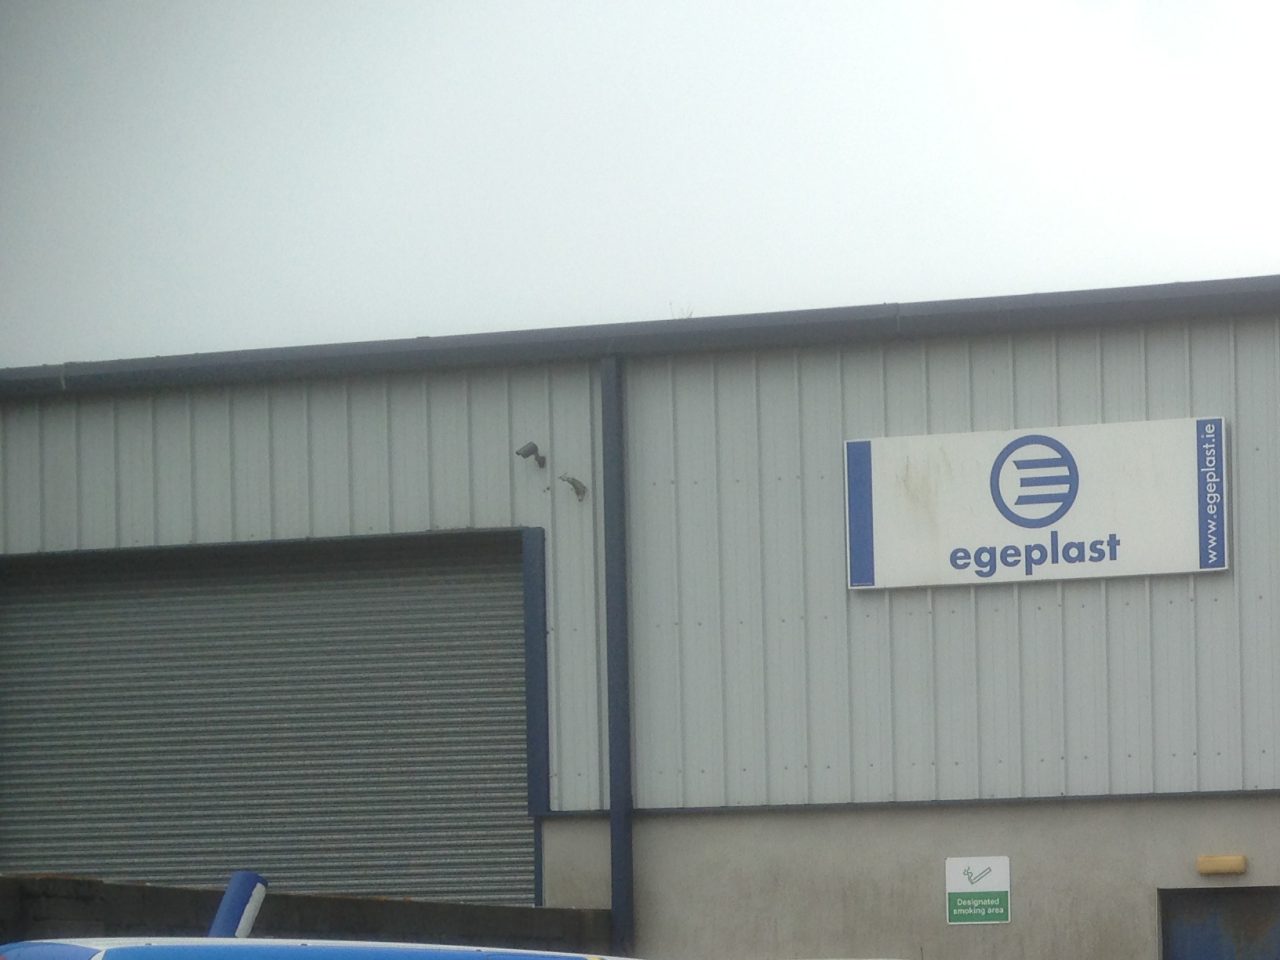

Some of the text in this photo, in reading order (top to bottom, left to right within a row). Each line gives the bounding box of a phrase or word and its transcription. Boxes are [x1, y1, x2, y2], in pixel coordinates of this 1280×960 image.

[1201, 422, 1221, 564] www.egeplast.ie
[950, 531, 1121, 578] egeplast
[953, 907, 986, 916] smoking
[956, 898, 1000, 906] Designated
